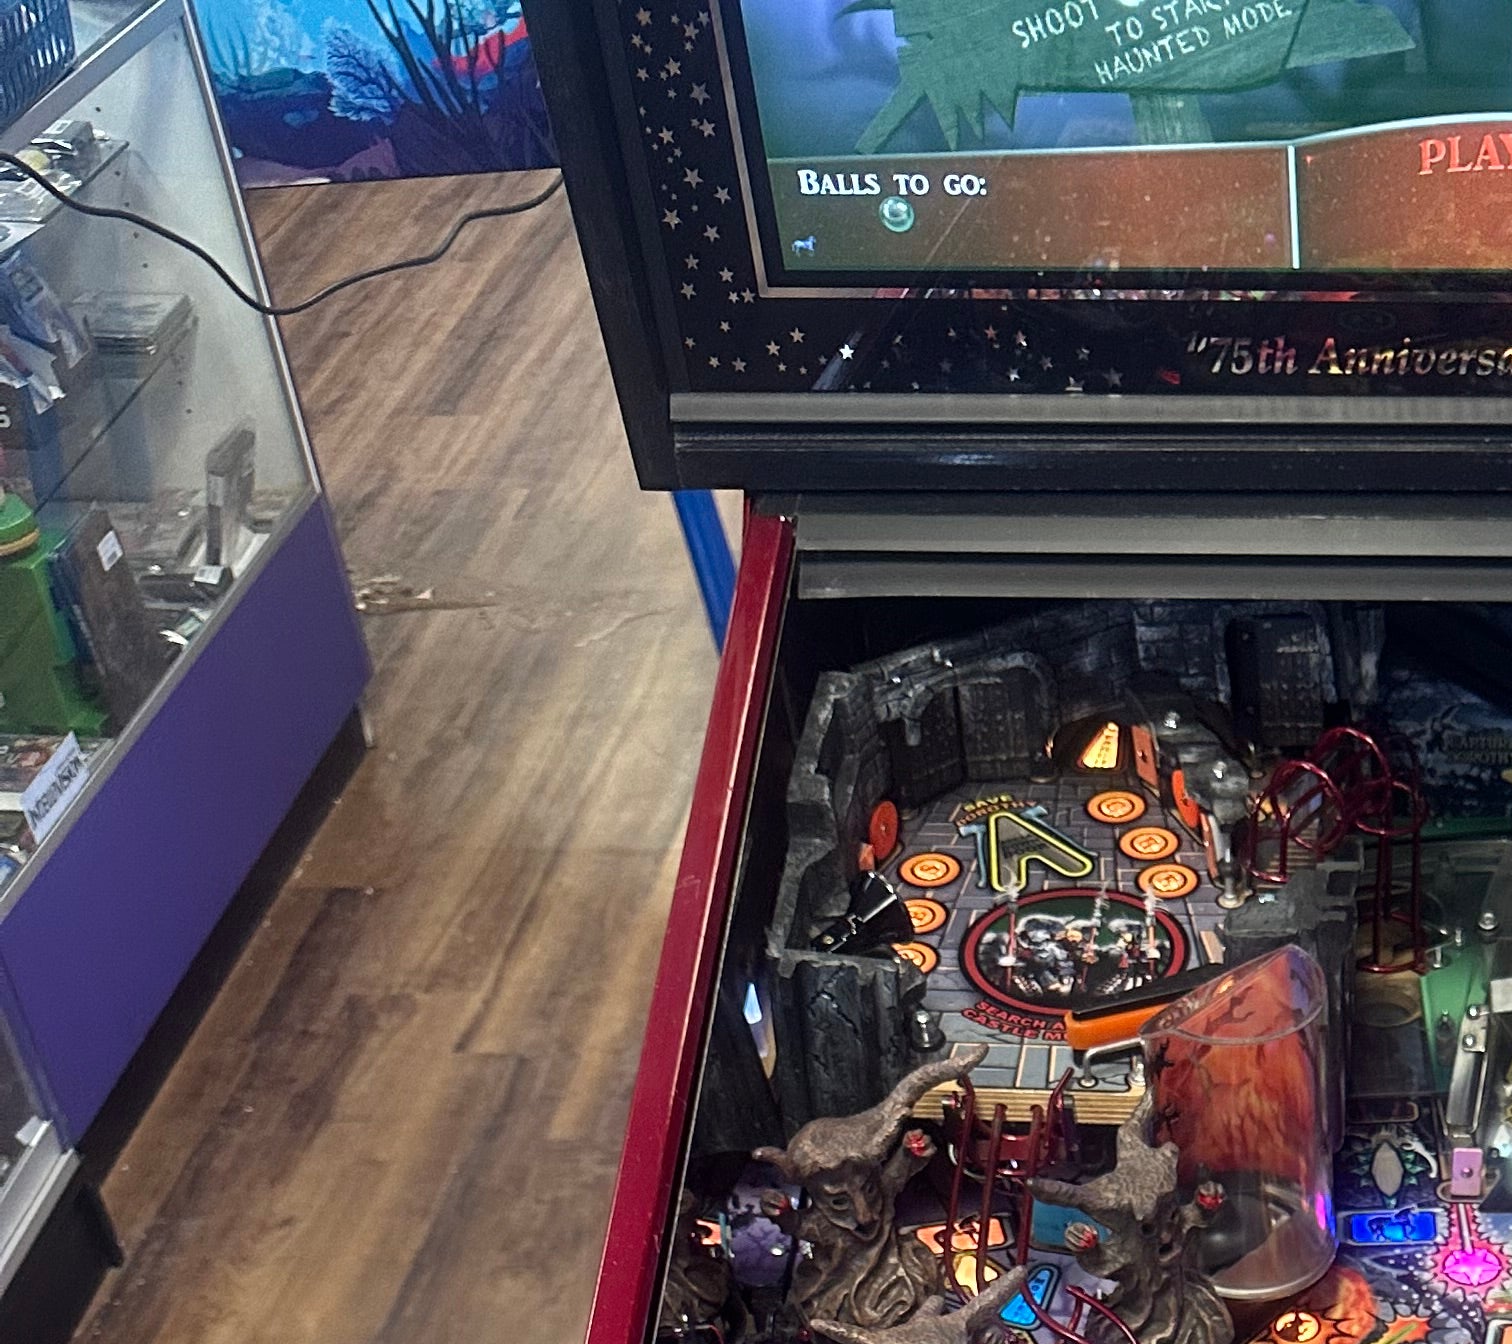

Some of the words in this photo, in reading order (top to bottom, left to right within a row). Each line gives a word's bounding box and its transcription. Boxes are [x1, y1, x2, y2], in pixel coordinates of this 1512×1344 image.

[1012, 0, 1098, 48] SHOOT
[1094, 26, 1211, 84] HAUNTED
[1223, 0, 1292, 39] MODE
[1105, 16, 1143, 46] TO
[1151, 0, 1230, 31] STAR
[961, 1008, 1038, 1039] CASTLE
[975, 1001, 1046, 1030] SEARCH
